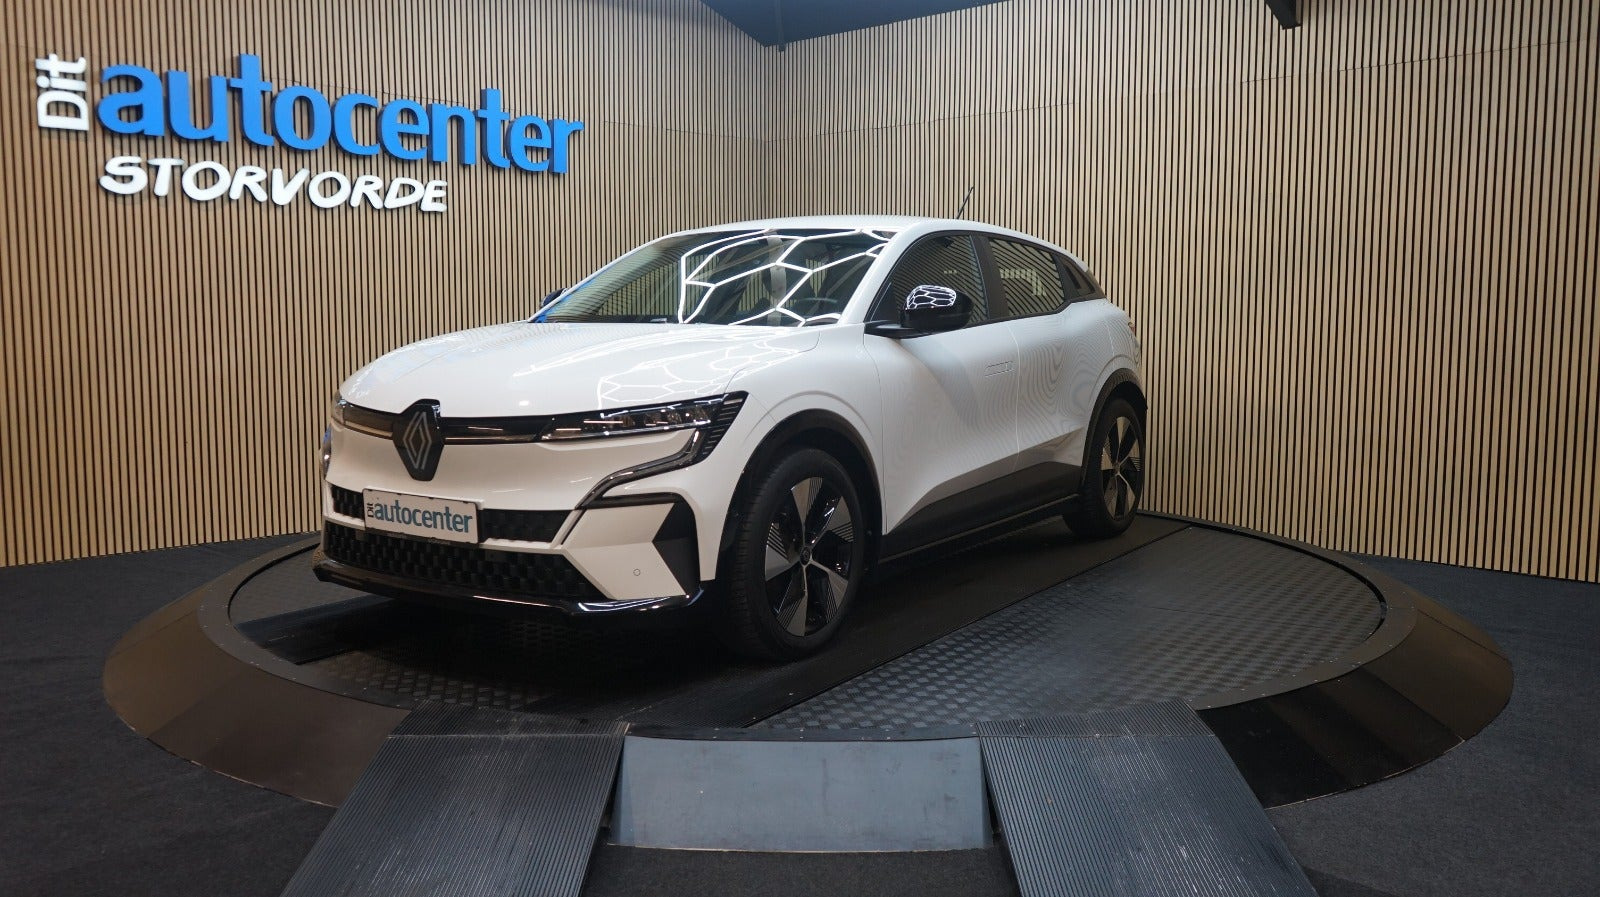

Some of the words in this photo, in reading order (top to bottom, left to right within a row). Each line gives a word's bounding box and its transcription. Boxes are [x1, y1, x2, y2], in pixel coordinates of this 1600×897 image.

[36, 53, 89, 131] Dit
[97, 53, 584, 174] autocenter
[99, 155, 448, 213] STORVORDE
[374, 500, 472, 533] autocenter
